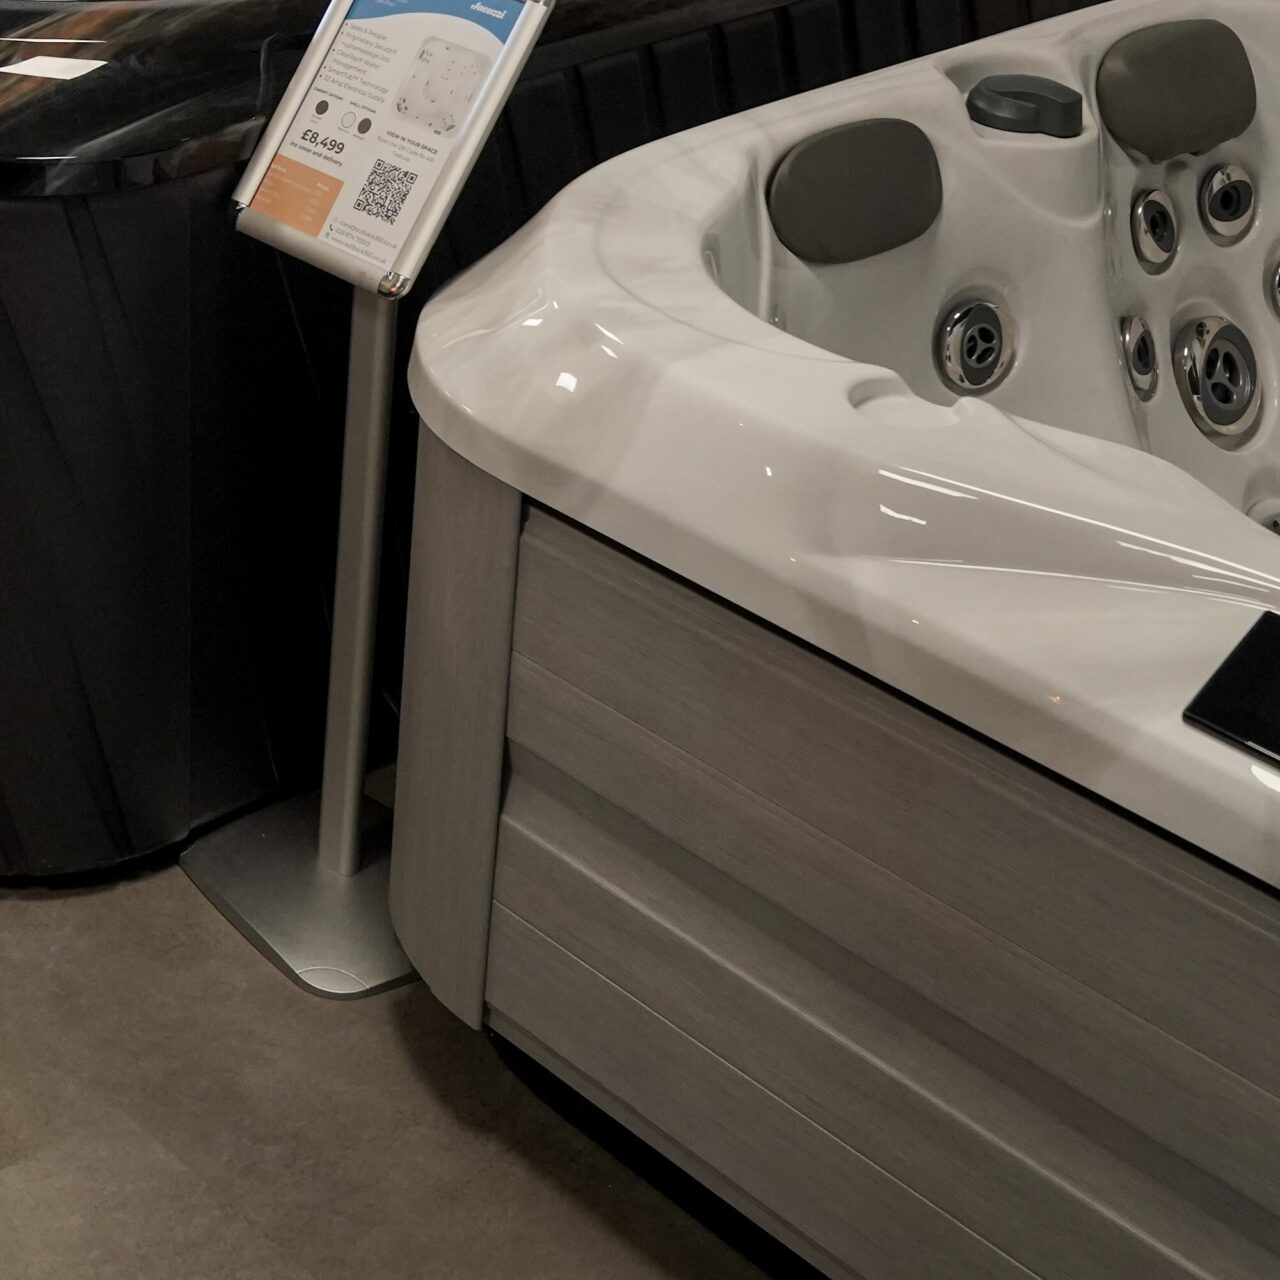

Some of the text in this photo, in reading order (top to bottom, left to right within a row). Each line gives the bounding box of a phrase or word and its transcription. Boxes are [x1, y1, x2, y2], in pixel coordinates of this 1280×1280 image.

[300, 129, 345, 154] £8,499
[386, 130, 400, 140] VIEW
[407, 138, 421, 148] YOUR
[421, 144, 438, 155] SPACE
[298, 144, 312, 154] cover
[312, 149, 322, 158] and
[322, 154, 343, 167] delivery
